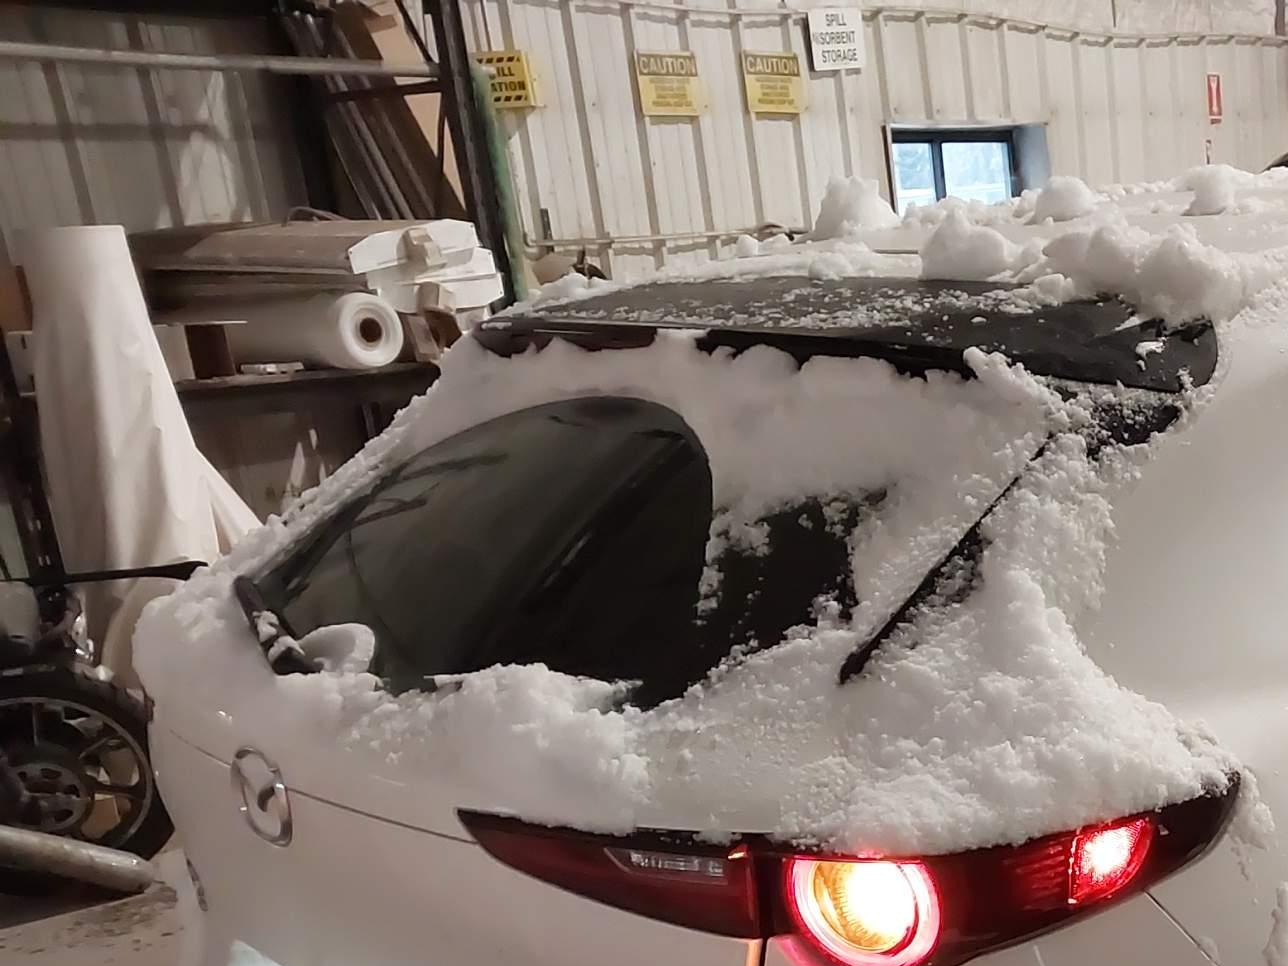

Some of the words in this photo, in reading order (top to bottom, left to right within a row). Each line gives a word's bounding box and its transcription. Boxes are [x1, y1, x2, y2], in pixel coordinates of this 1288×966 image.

[825, 13, 847, 26] SPILL
[822, 48, 858, 63] STORAGE
[640, 56, 696, 74] CAUTION
[746, 56, 798, 74] CAUTION
